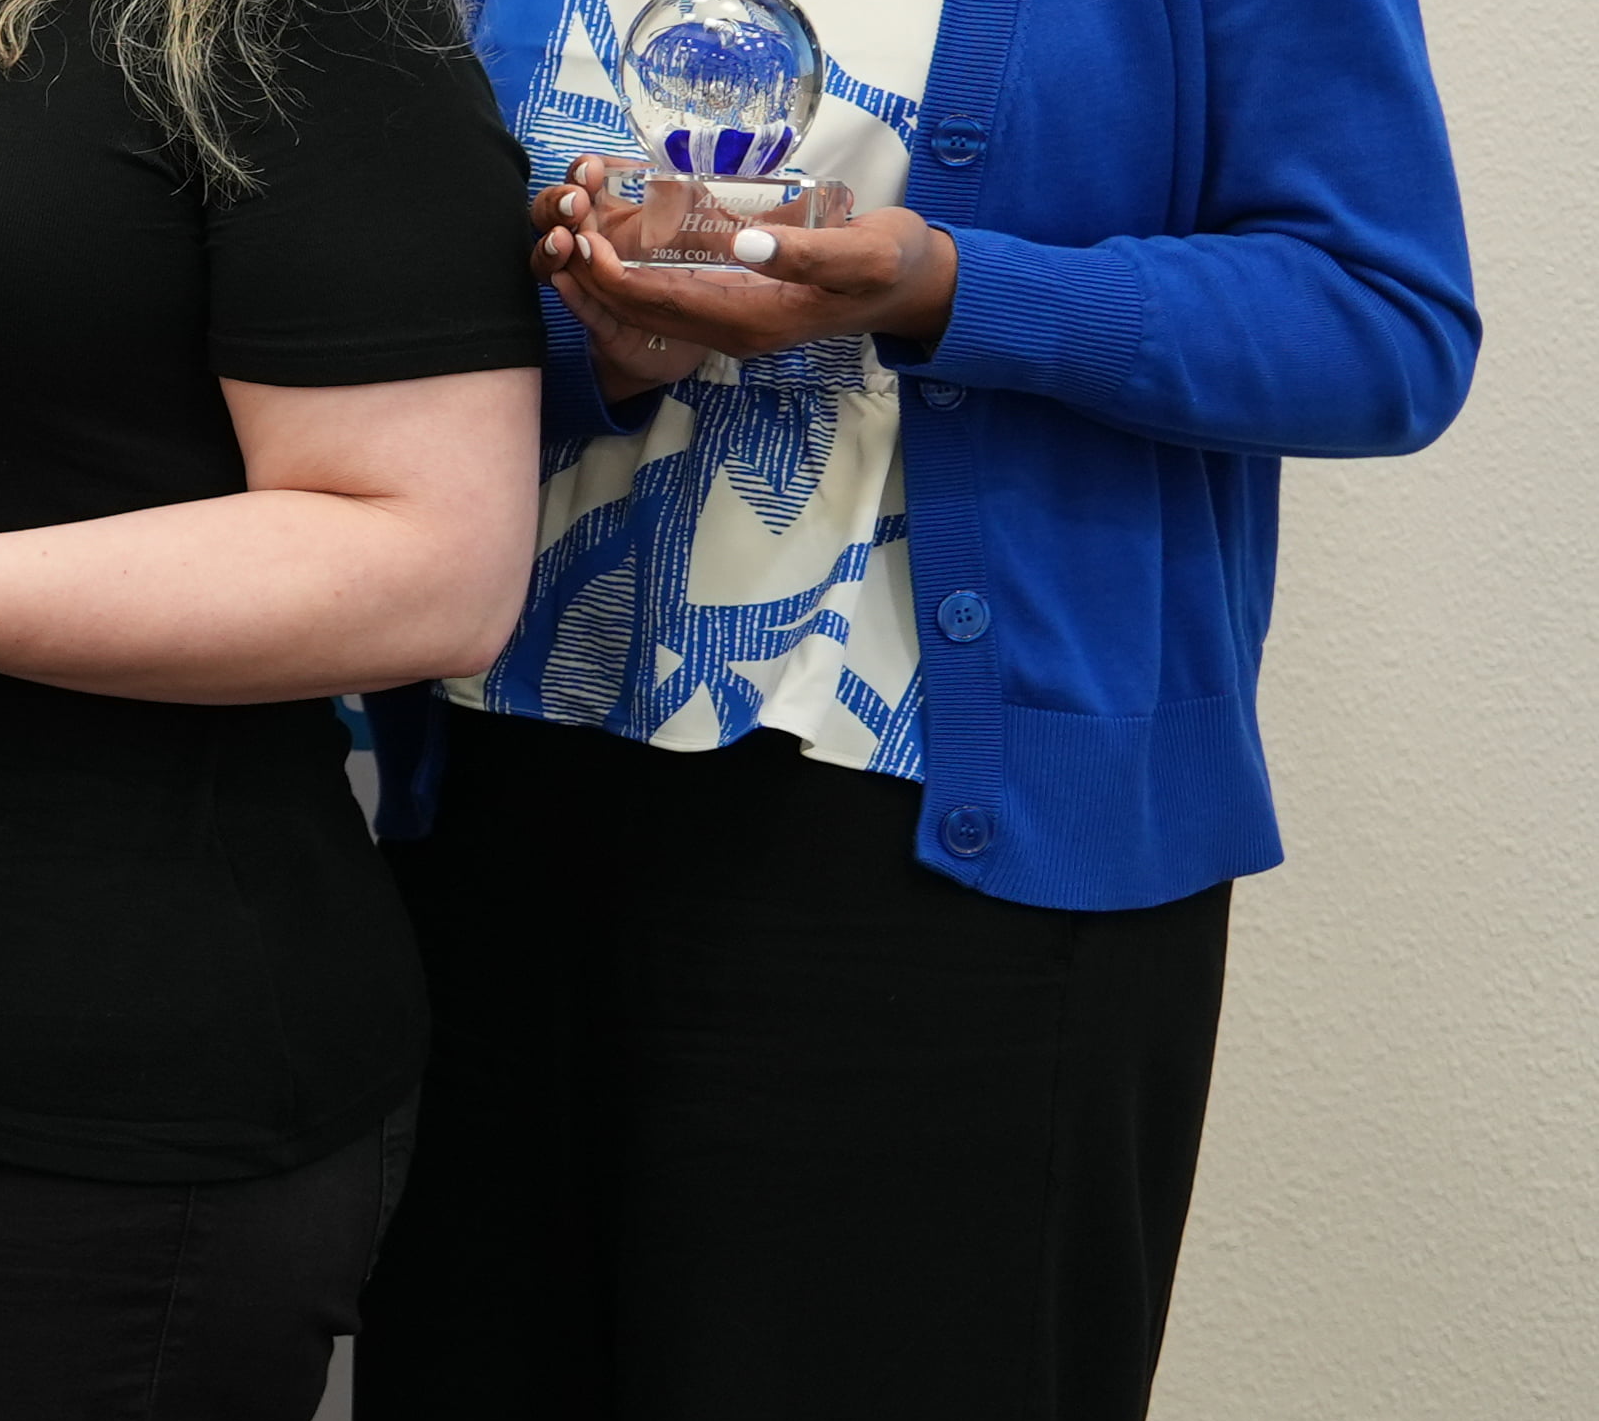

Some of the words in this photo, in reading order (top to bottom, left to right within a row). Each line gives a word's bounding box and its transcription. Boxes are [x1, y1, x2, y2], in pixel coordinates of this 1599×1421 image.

[695, 192, 779, 217] Angela
[652, 248, 681, 260] 2026
[684, 250, 727, 262] COLA
